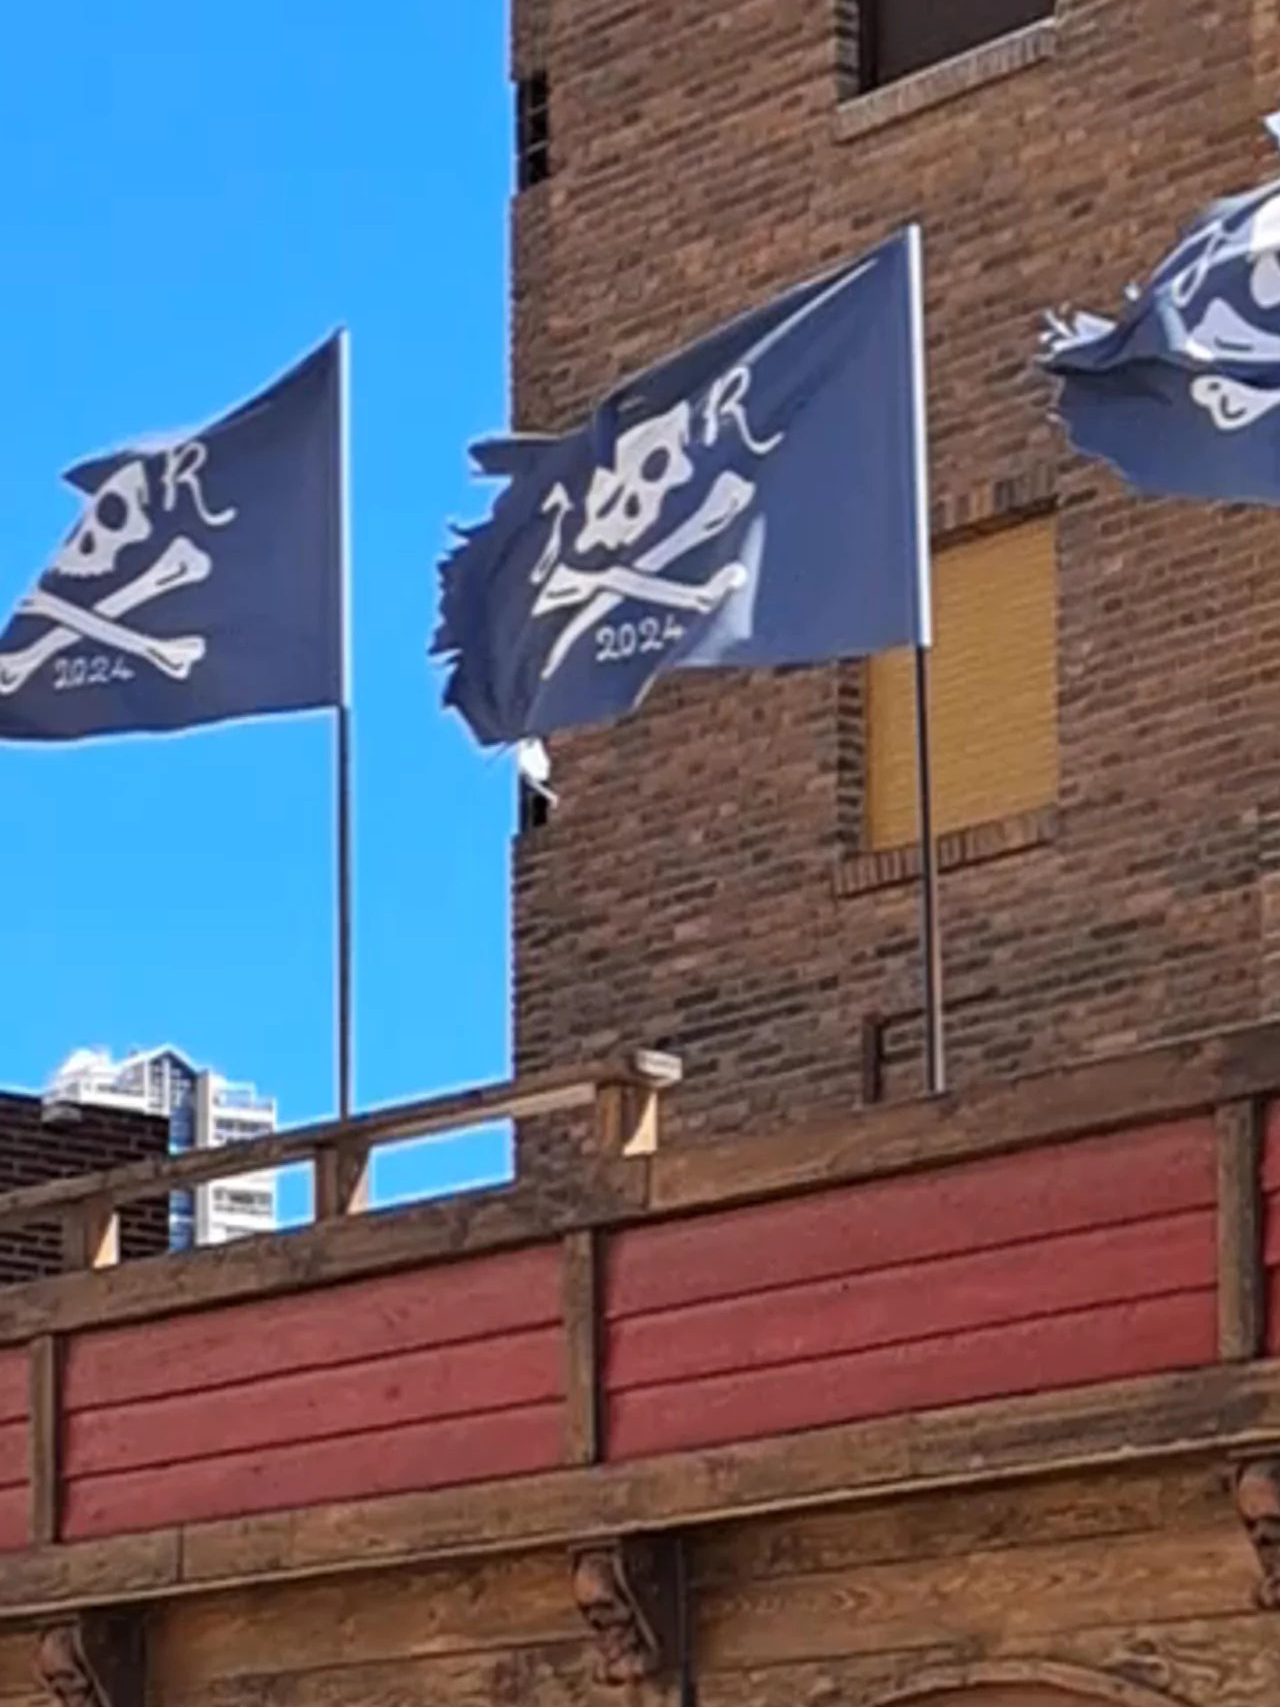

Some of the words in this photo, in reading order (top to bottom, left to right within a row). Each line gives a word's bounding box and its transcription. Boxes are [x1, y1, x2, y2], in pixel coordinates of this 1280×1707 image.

[700, 364, 785, 455] R
[162, 442, 238, 526] R
[594, 614, 686, 663] 2024
